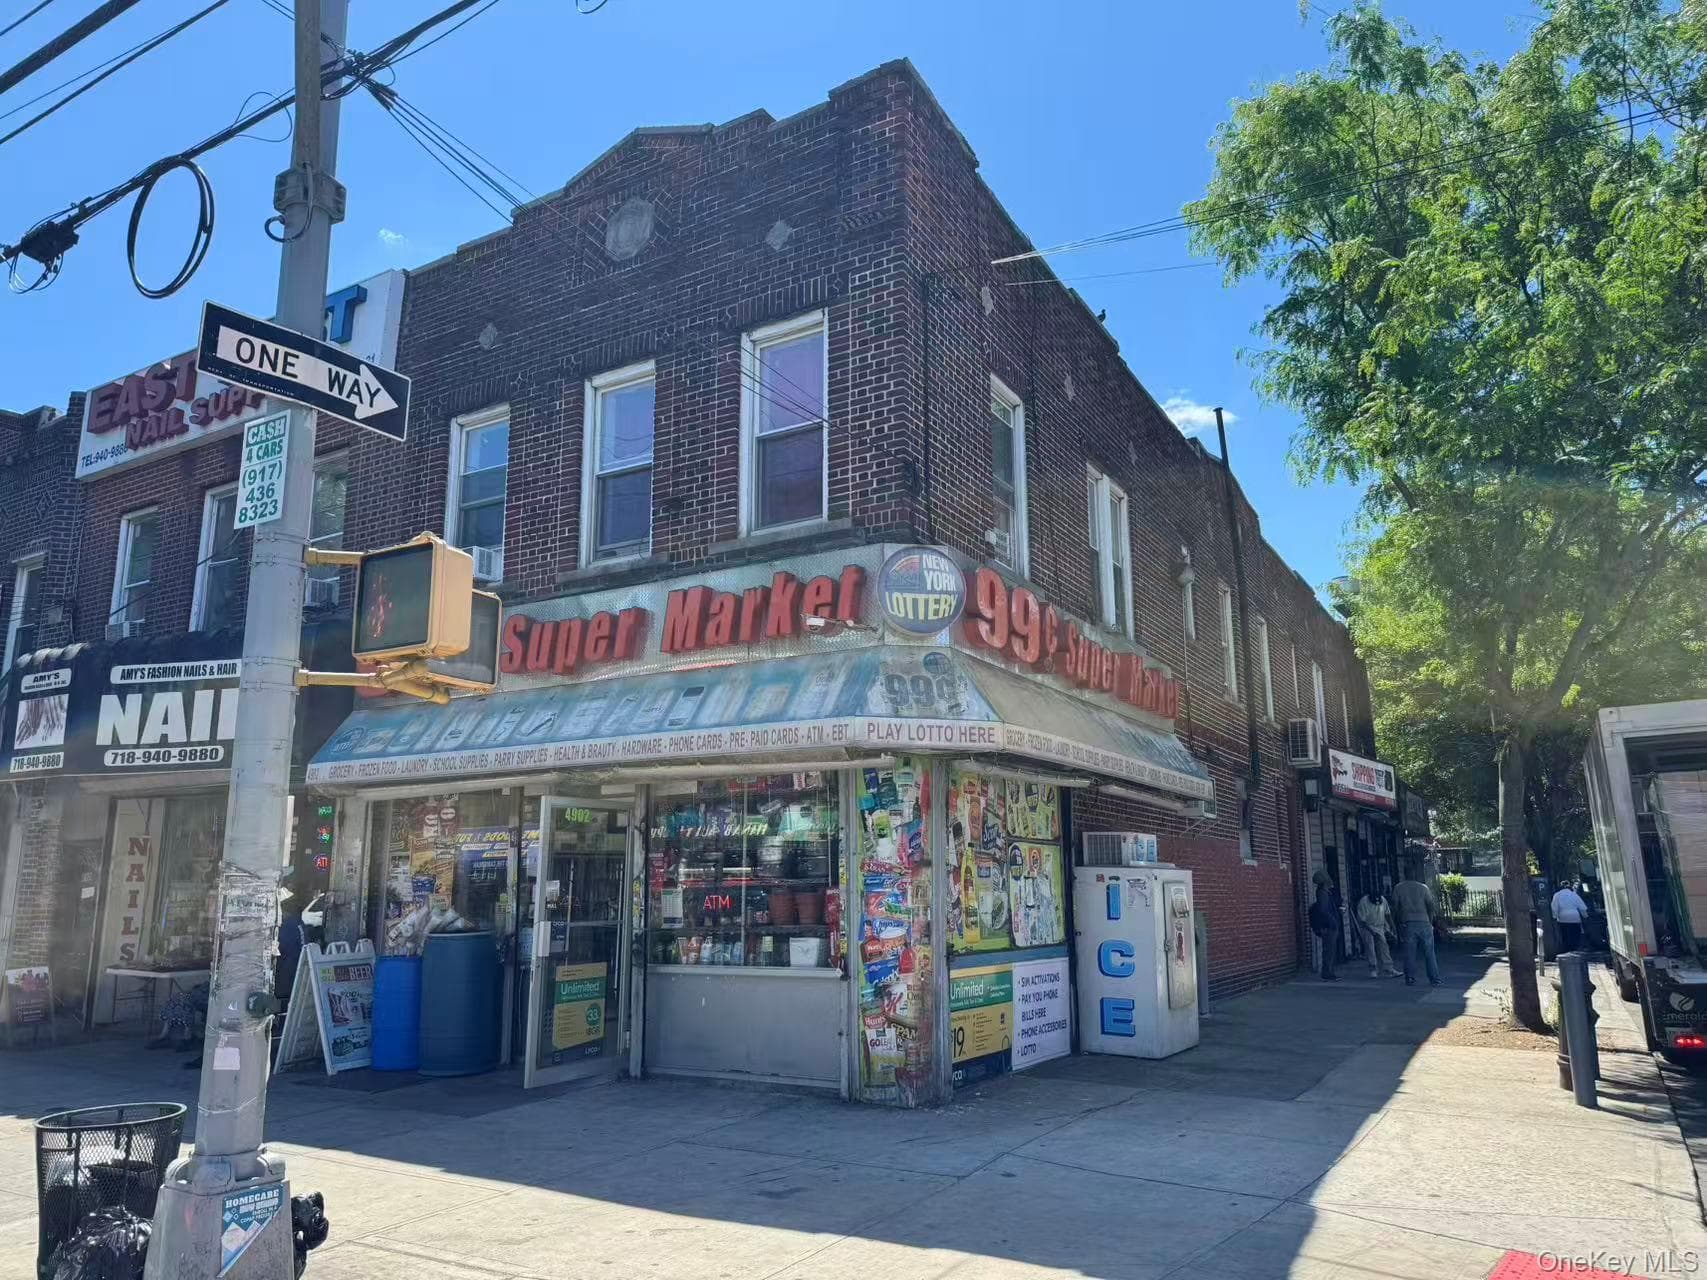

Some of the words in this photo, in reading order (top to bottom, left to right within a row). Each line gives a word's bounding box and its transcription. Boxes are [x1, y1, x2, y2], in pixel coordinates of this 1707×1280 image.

[235, 337, 300, 379] ONE
[328, 367, 381, 408] WAY
[87, 353, 197, 434] EAST
[126, 407, 189, 451] NAIL
[247, 417, 286, 445] CASH
[246, 447, 253, 463] 4
[256, 438, 283, 460] CARS
[242, 460, 283, 488] (917)
[246, 482, 275, 503] 436
[239, 499, 278, 523] 8323
[923, 553, 949, 570] NEW
[925, 569, 956, 592] YORK
[885, 591, 959, 621] LOTTERY
[501, 605, 645, 675] Super
[661, 564, 865, 657] Market
[120, 668, 146, 681] AMY'S
[147, 666, 182, 679] FASHION
[183, 664, 207, 677] NAILS
[208, 665, 215, 676] &
[216, 662, 238, 676] HAIR
[867, 722, 903, 740] PLAY
[908, 724, 954, 743] LOTTO
[958, 726, 996, 743] HERE
[111, 748, 219, 765] 718-940-9880
[358, 760, 381, 776] FROZEN
[401, 756, 429, 773] LAUNDRY
[433, 752, 458, 770] SCHOOL
[459, 752, 489, 769] SUPPLIES
[516, 747, 548, 764] SUPPLIES
[554, 745, 580, 761] HEALTH
[622, 736, 662, 754] HARDWARE
[669, 734, 695, 752] PHONE
[696, 732, 722, 750] CARDS
[750, 728, 770, 746] PAID
[771, 726, 799, 744] CARDS
[806, 724, 824, 741] ATM
[832, 722, 849, 739] EBT
[13, 754, 61, 770] 718-940-9880
[564, 807, 594, 822] 4902
[120, 836, 152, 961] NAILS
[704, 895, 732, 912] ATM
[1097, 882, 1137, 1037] ICE
[561, 980, 600, 995] Unlimited
[950, 977, 984, 1000] Unlimited
[1021, 976, 1031, 987] SIM
[1031, 972, 1060, 986] ACTIVATIONS
[1033, 990, 1043, 1002] YOU
[1044, 988, 1058, 1000] PHONE
[1022, 1010, 1035, 1021] BILLS
[1035, 1007, 1047, 1019] HERE
[1021, 1026, 1038, 1039] PHONE
[1020, 1043, 1037, 1057] LOTTO
[225, 1189, 279, 1209] HOMECARE
